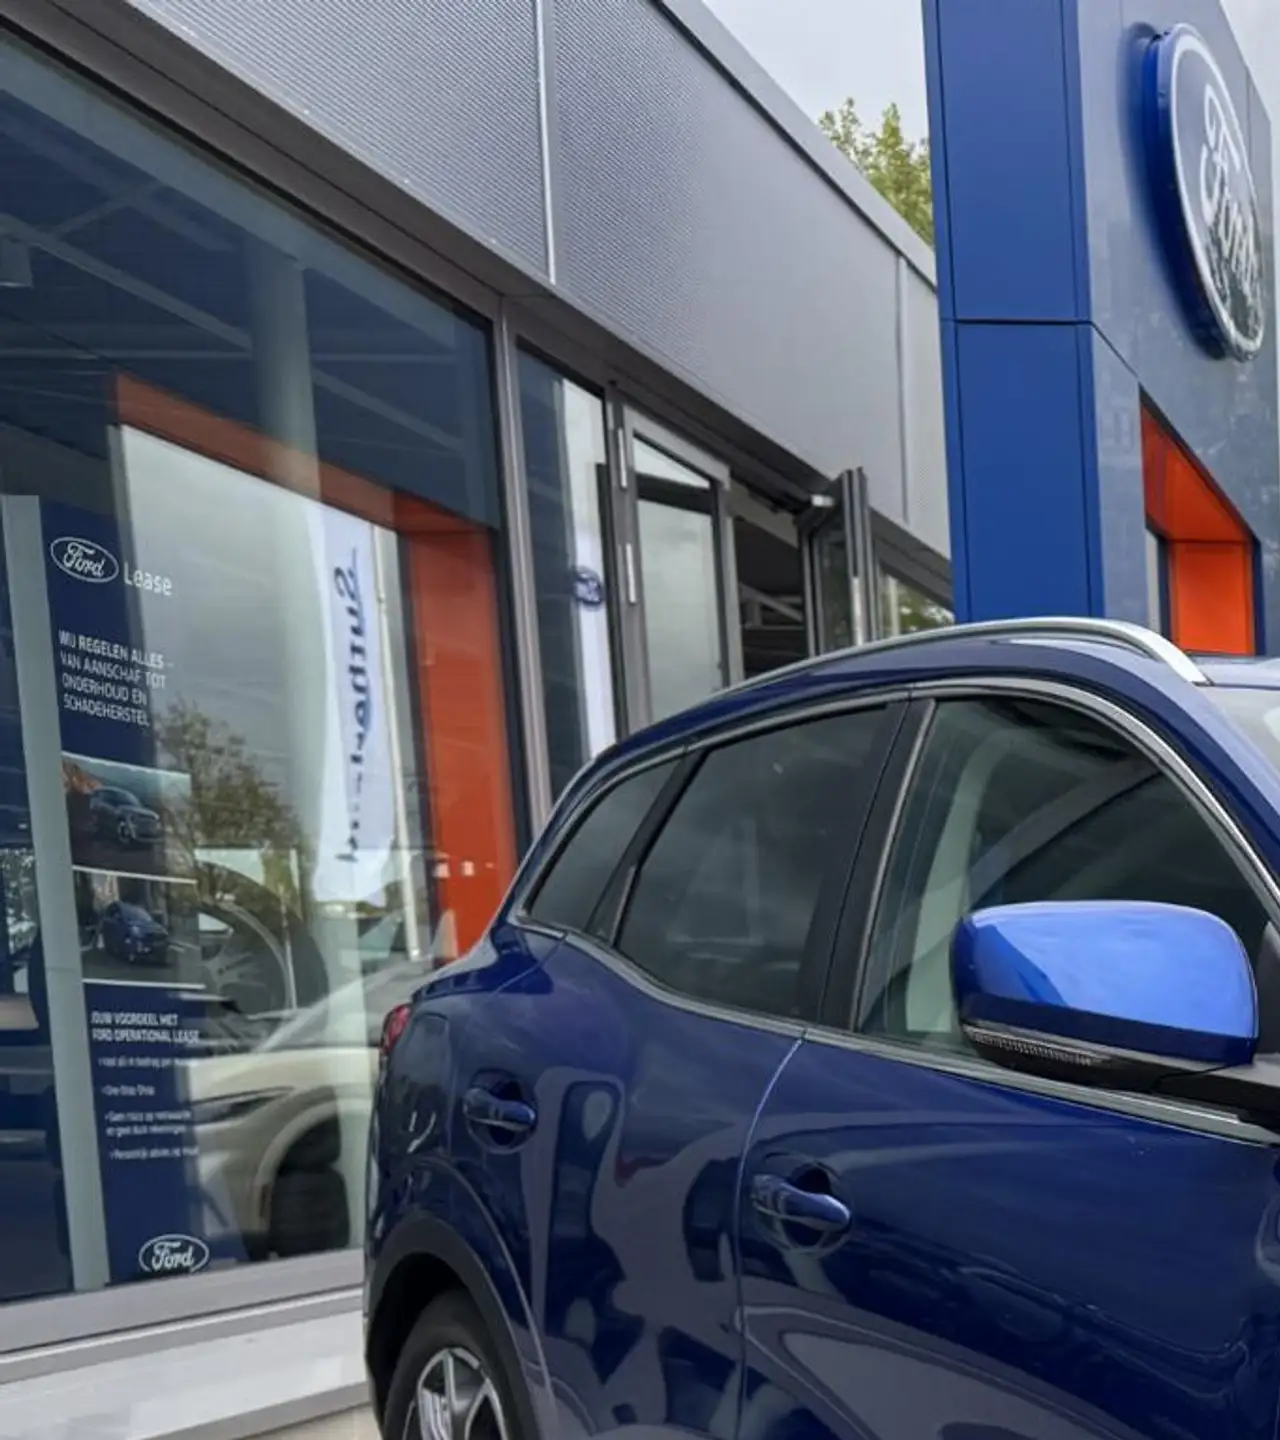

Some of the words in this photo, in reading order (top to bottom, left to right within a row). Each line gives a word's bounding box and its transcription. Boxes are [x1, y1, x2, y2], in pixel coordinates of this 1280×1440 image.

[1201, 83, 1258, 305] Ford
[63, 542, 105, 577] Ford
[124, 561, 172, 596] Lease
[59, 629, 76, 648] WIJ
[78, 634, 128, 661] REGELEN
[131, 648, 164, 669] ALLES
[61, 650, 81, 670] VAN
[83, 657, 141, 682] AANSCHAF
[145, 671, 166, 689] TOT
[62, 672, 129, 702] ONDERHOUD
[131, 687, 147, 706] EN
[63, 693, 150, 727] SCHADEHERSTEL
[172, 1030, 199, 1044] LEASE
[151, 1241, 194, 1271] Ford
